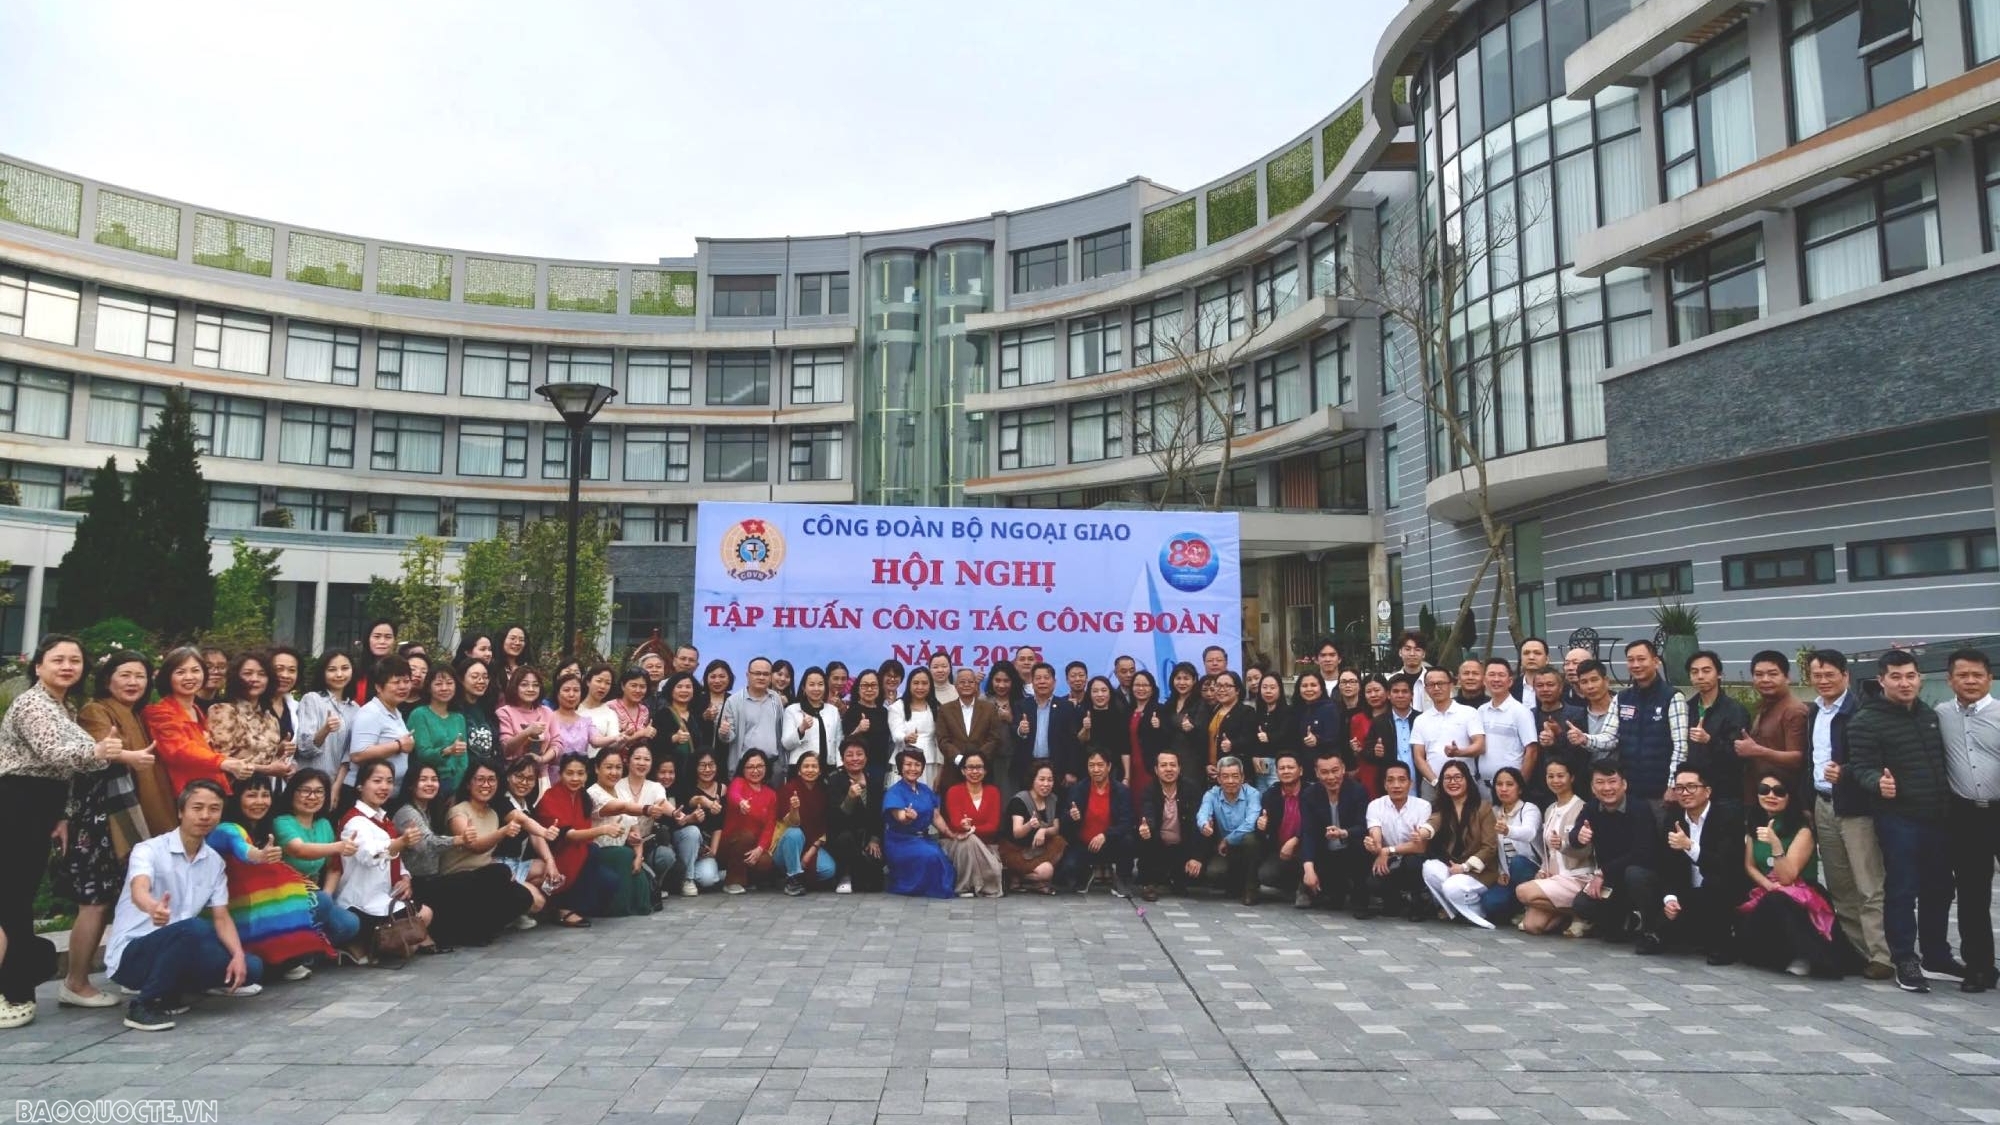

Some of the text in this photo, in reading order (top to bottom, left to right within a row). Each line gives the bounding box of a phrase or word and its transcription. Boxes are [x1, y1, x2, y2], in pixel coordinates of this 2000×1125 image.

[803, 514, 1131, 545] CÔNG ĐOÀN BỘ NGOẠI GIAO
[872, 551, 1056, 594] HỘI NGHỊ
[704, 600, 1220, 634] TẬP HUẤN CÔNG TÁC CÔNG ĐOÀN
[891, 639, 964, 666] NĂM
